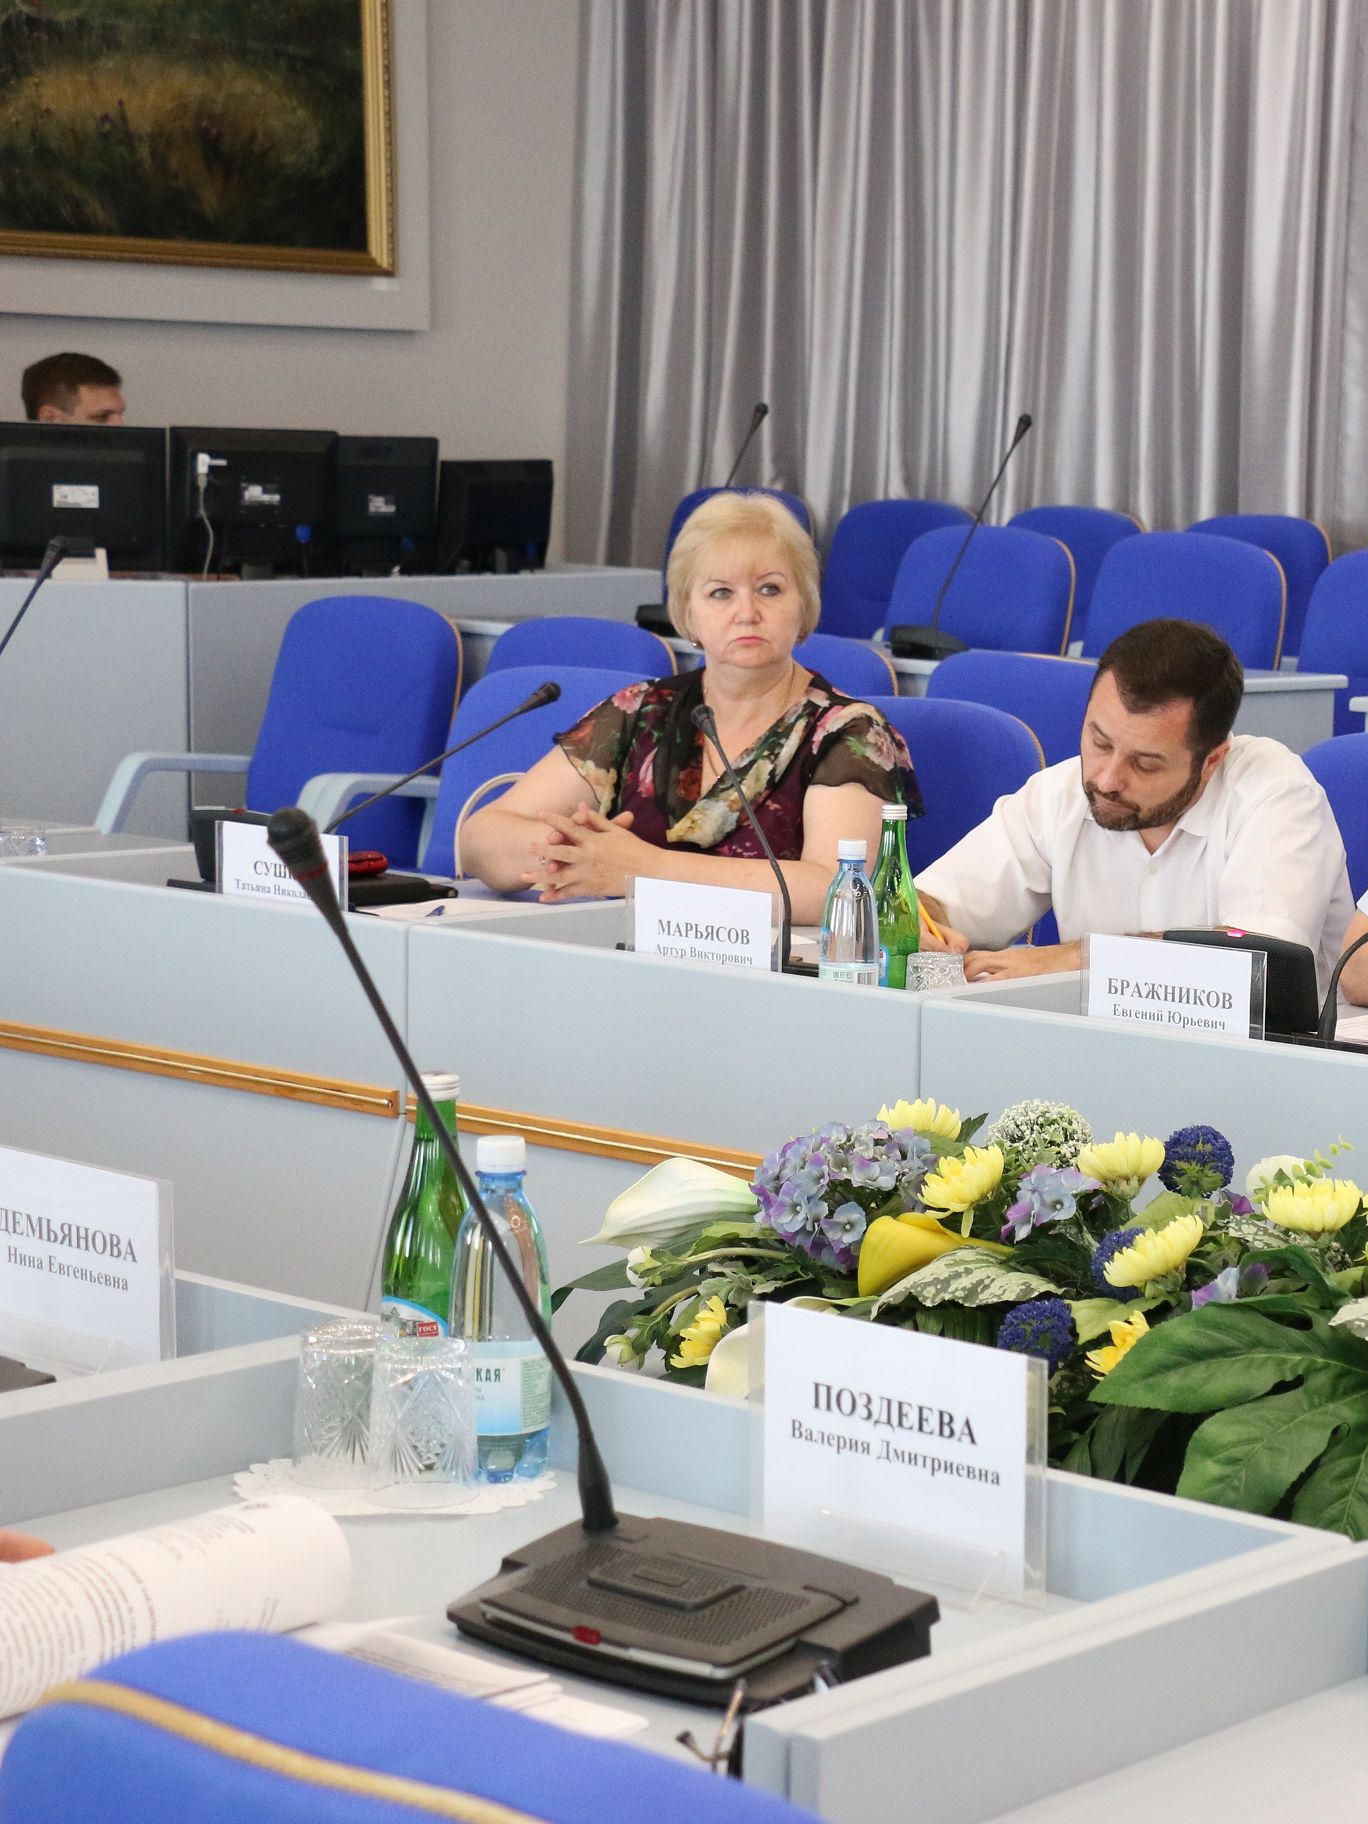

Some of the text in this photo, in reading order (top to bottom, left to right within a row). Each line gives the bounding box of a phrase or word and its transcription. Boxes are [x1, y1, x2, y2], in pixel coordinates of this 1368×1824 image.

[253, 860, 292, 880] СУШ
[234, 878, 272, 895] Татьяна
[657, 919, 750, 946] МАРЬЯСОВ
[654, 943, 753, 966] Артур Викторович
[1107, 976, 1233, 1010] БРАЖНИКОВ
[1112, 1003, 1226, 1031] Евгений Юрьевич
[0, 1207, 139, 1264] ДЕМЬЯНОВА
[7, 1244, 129, 1292] Нина Евгеньевна
[812, 1381, 979, 1447] ПОЗДЕЕВА
[790, 1418, 1001, 1487] Валерия Дмитриевна
